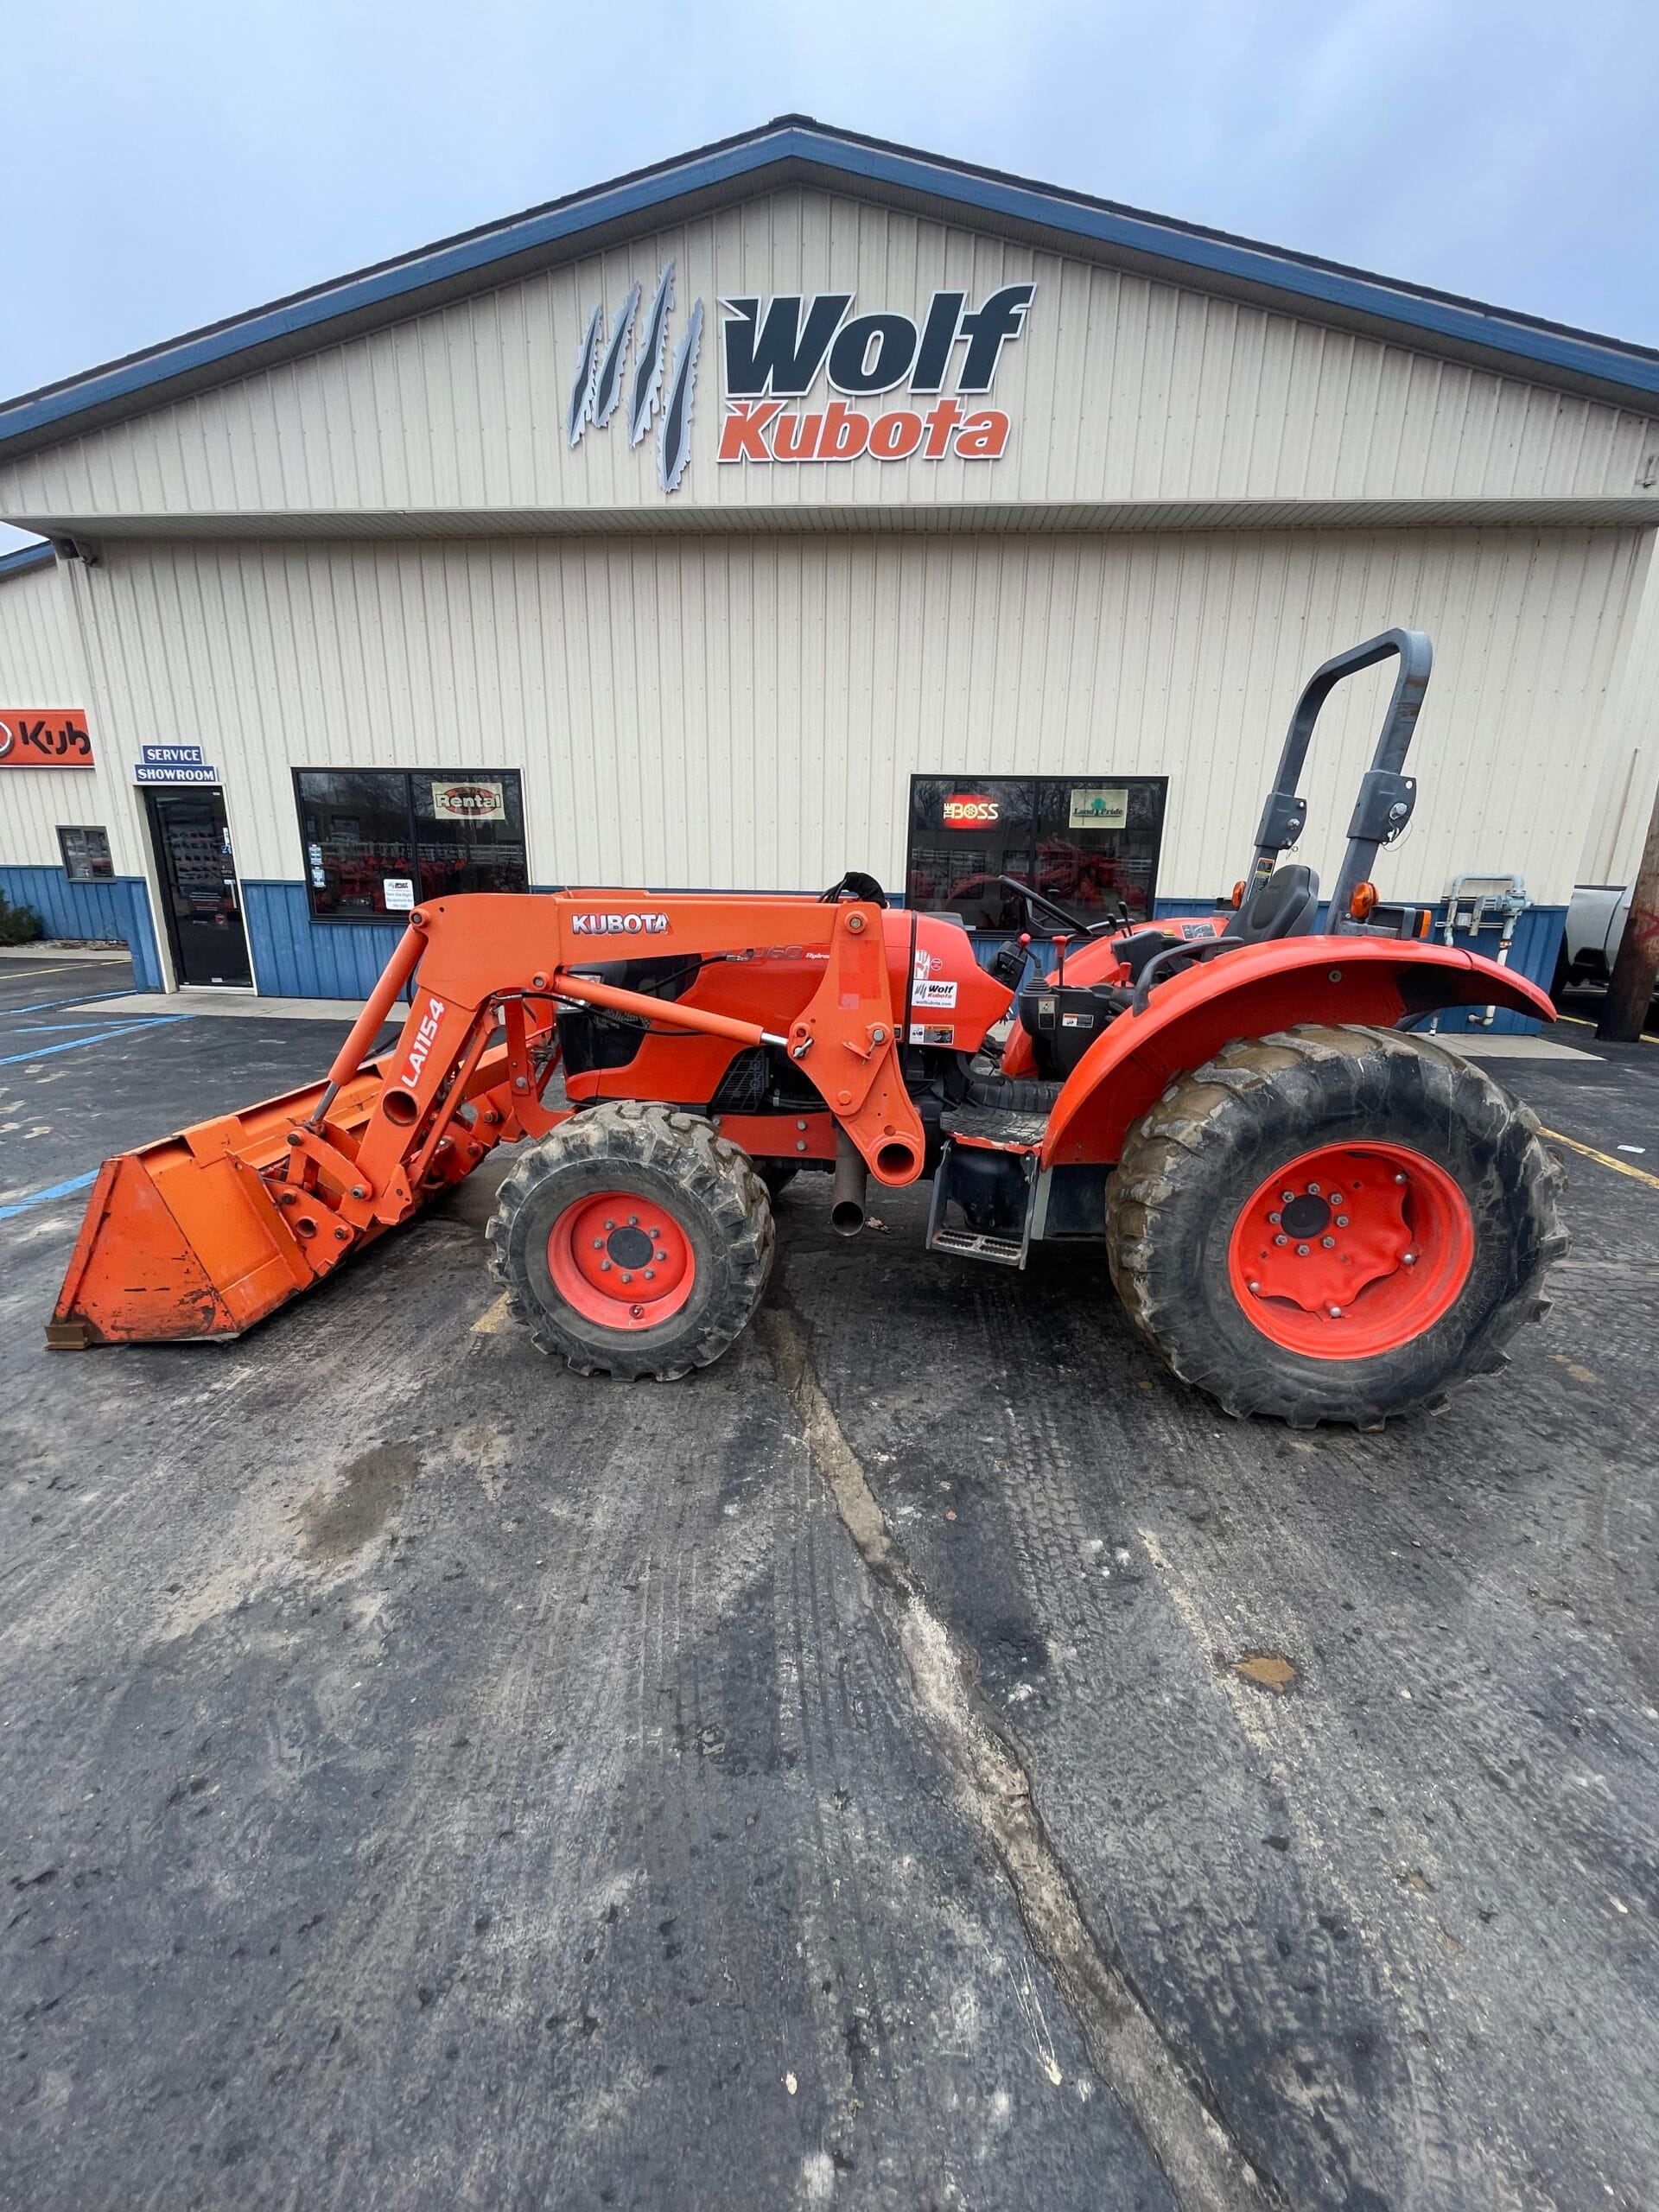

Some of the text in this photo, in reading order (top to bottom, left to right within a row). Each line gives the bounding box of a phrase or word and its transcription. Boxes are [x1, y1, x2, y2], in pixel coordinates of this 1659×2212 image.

[717, 283, 1037, 397] Wolf
[717, 398, 1010, 462] Kubota
[18, 721, 91, 755] Kub
[146, 749, 200, 761] SERVICE
[137, 768, 214, 781] SHOWROOM
[435, 793, 501, 808] Rental
[944, 803, 999, 820] THE BOSS
[572, 913, 668, 934] KUBOTA
[929, 984, 954, 994] Wolf
[401, 998, 445, 1088] LA1154
